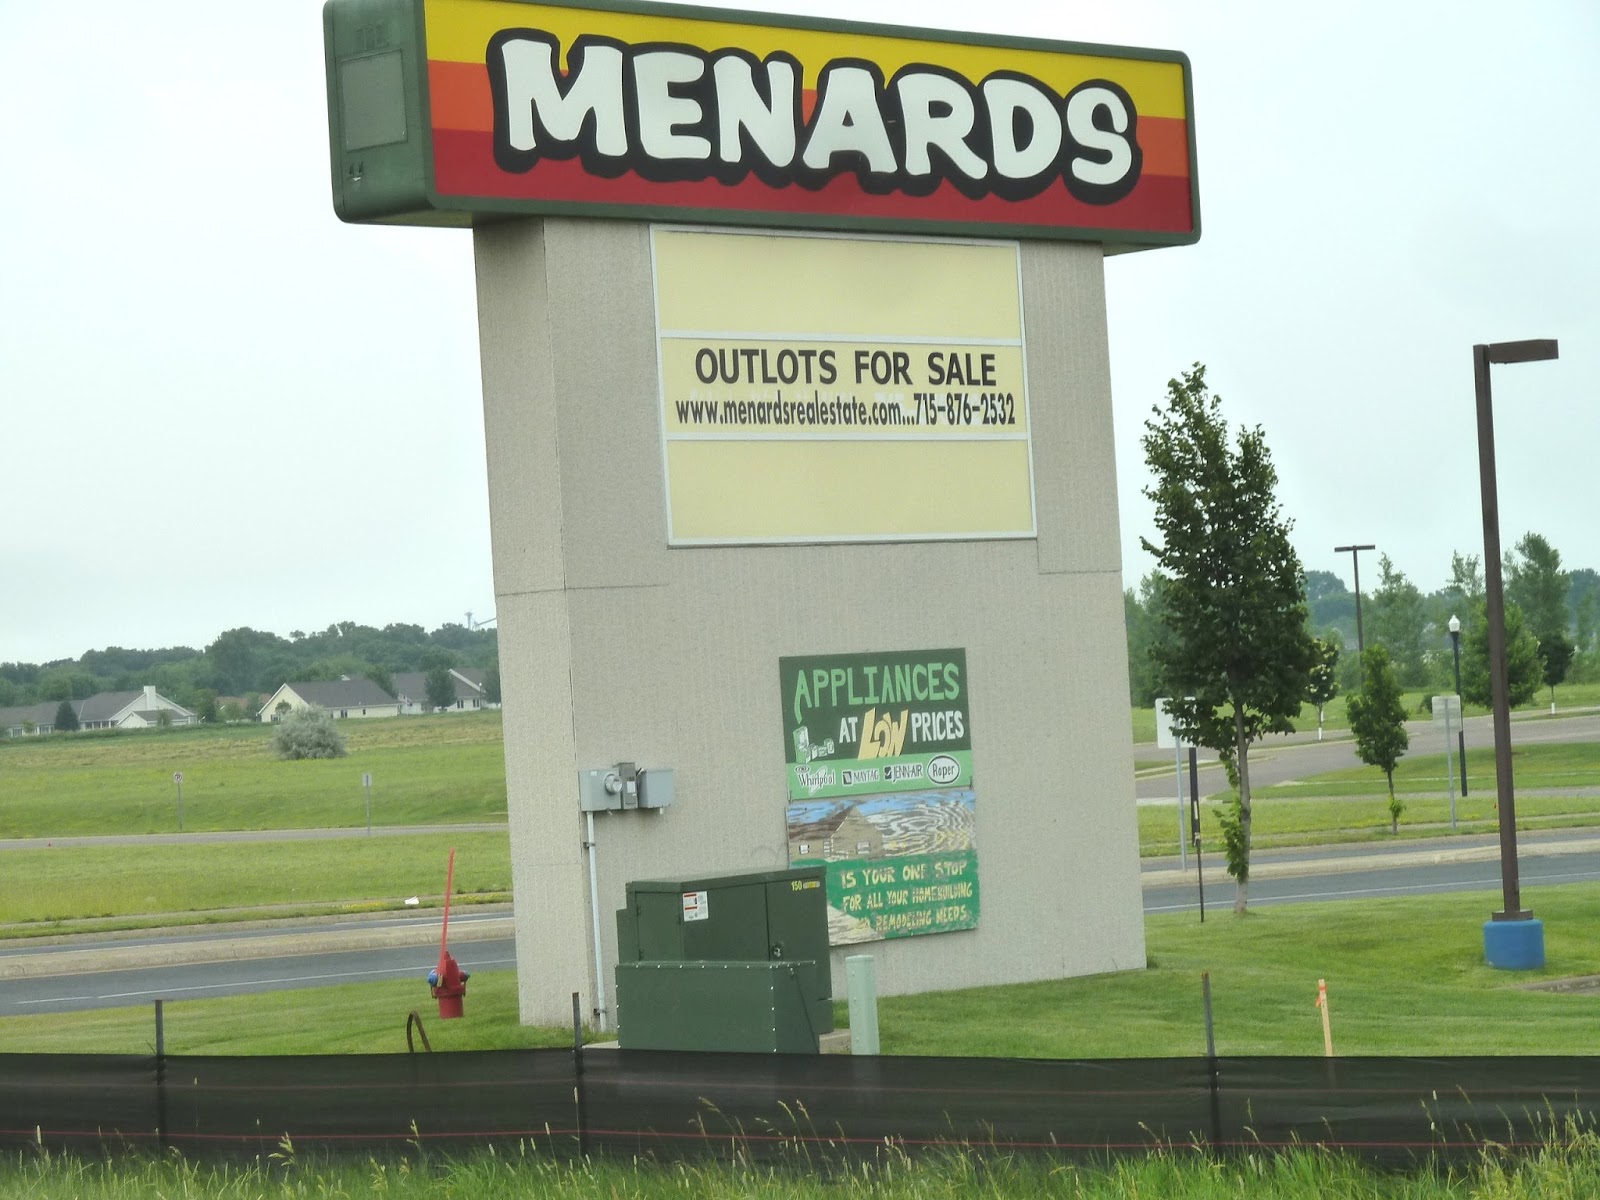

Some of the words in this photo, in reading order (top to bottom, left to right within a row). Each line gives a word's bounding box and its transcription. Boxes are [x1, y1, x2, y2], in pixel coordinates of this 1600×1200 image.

[494, 31, 1139, 196] MENARDS
[694, 347, 838, 385] OUTLOTS
[855, 350, 913, 386] FOR
[927, 352, 997, 387] SALE
[794, 662, 961, 724] APPLIANCES
[838, 716, 858, 744] AT
[857, 707, 909, 762] LOW
[911, 710, 965, 743] PRICES
[798, 770, 835, 788] Whirlpool
[853, 769, 879, 782] MAYTAG
[932, 763, 955, 779] Roper
[791, 880, 803, 891] 150
[841, 871, 857, 889] IS
[862, 866, 896, 887] YOUR
[935, 860, 967, 878] STOP
[843, 894, 862, 912] FOR
[866, 891, 884, 909] ALL
[886, 889, 909, 906] YOUR
[936, 904, 967, 924] NEEDS
